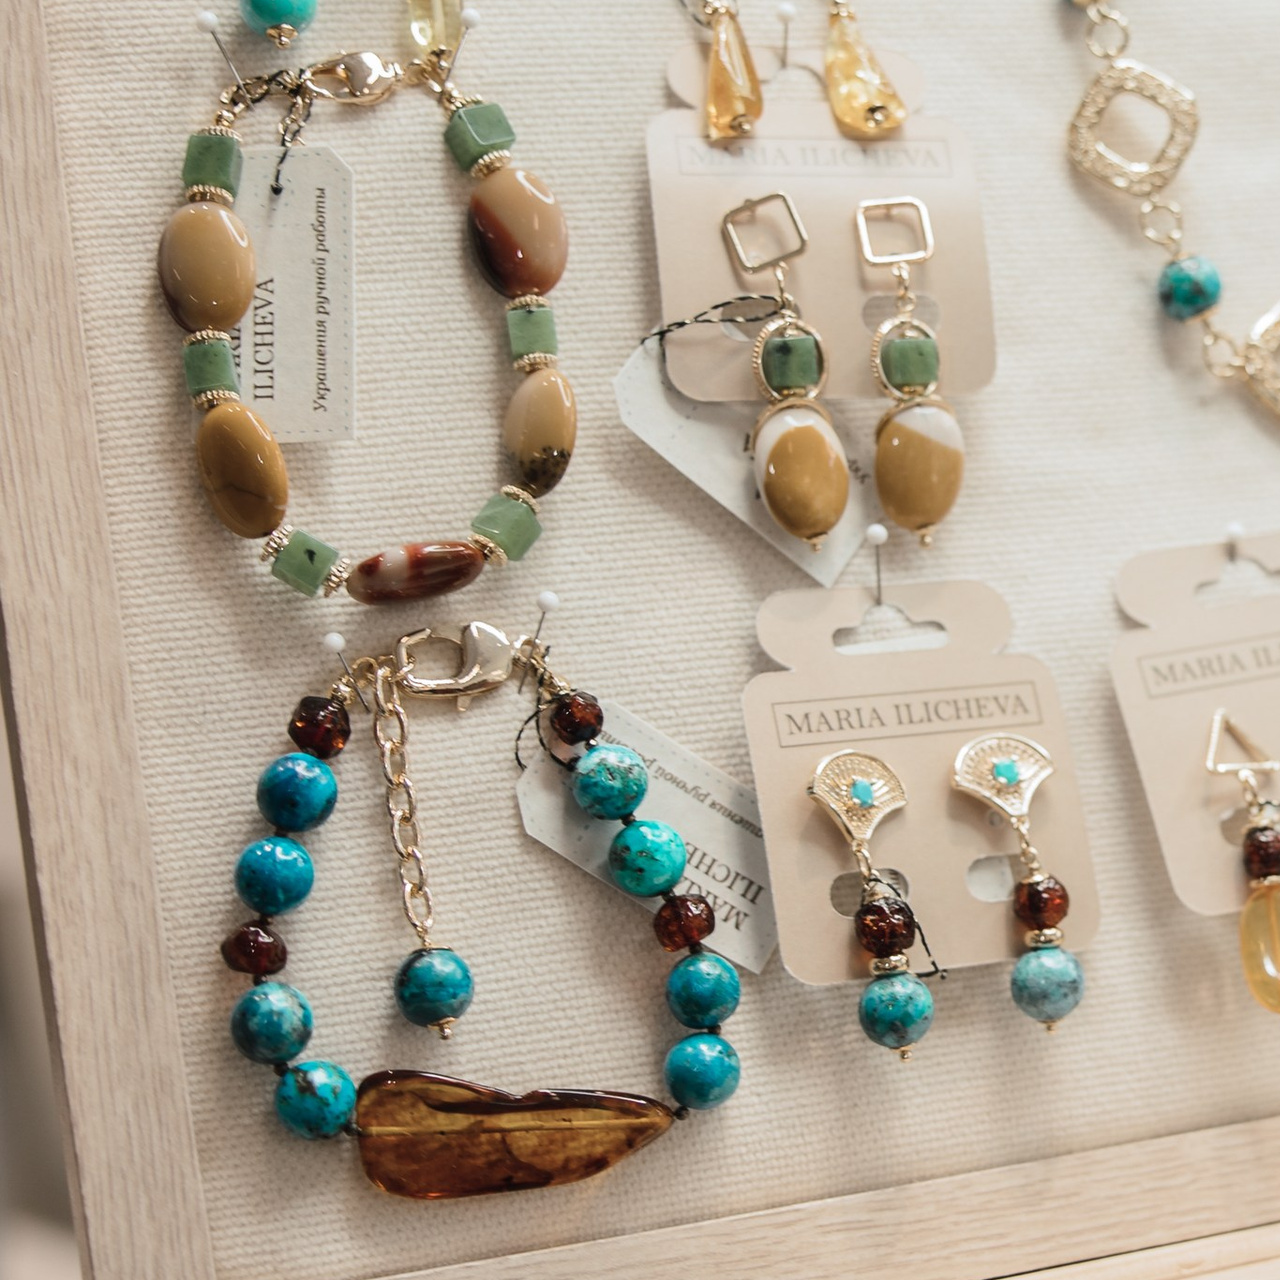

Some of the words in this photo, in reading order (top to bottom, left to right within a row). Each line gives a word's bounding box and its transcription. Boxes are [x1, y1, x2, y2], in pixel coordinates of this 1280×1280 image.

[311, 187, 330, 253] работы
[311, 259, 330, 316] ручной
[253, 277, 275, 401] ILICHEVA
[312, 320, 331, 412] Украшения
[1151, 652, 1248, 687] MARIA
[784, 705, 888, 736] MARIA
[890, 693, 1030, 726] ILICHEVA
[653, 765, 711, 810] ручной
[684, 840, 768, 905] ILICHE
